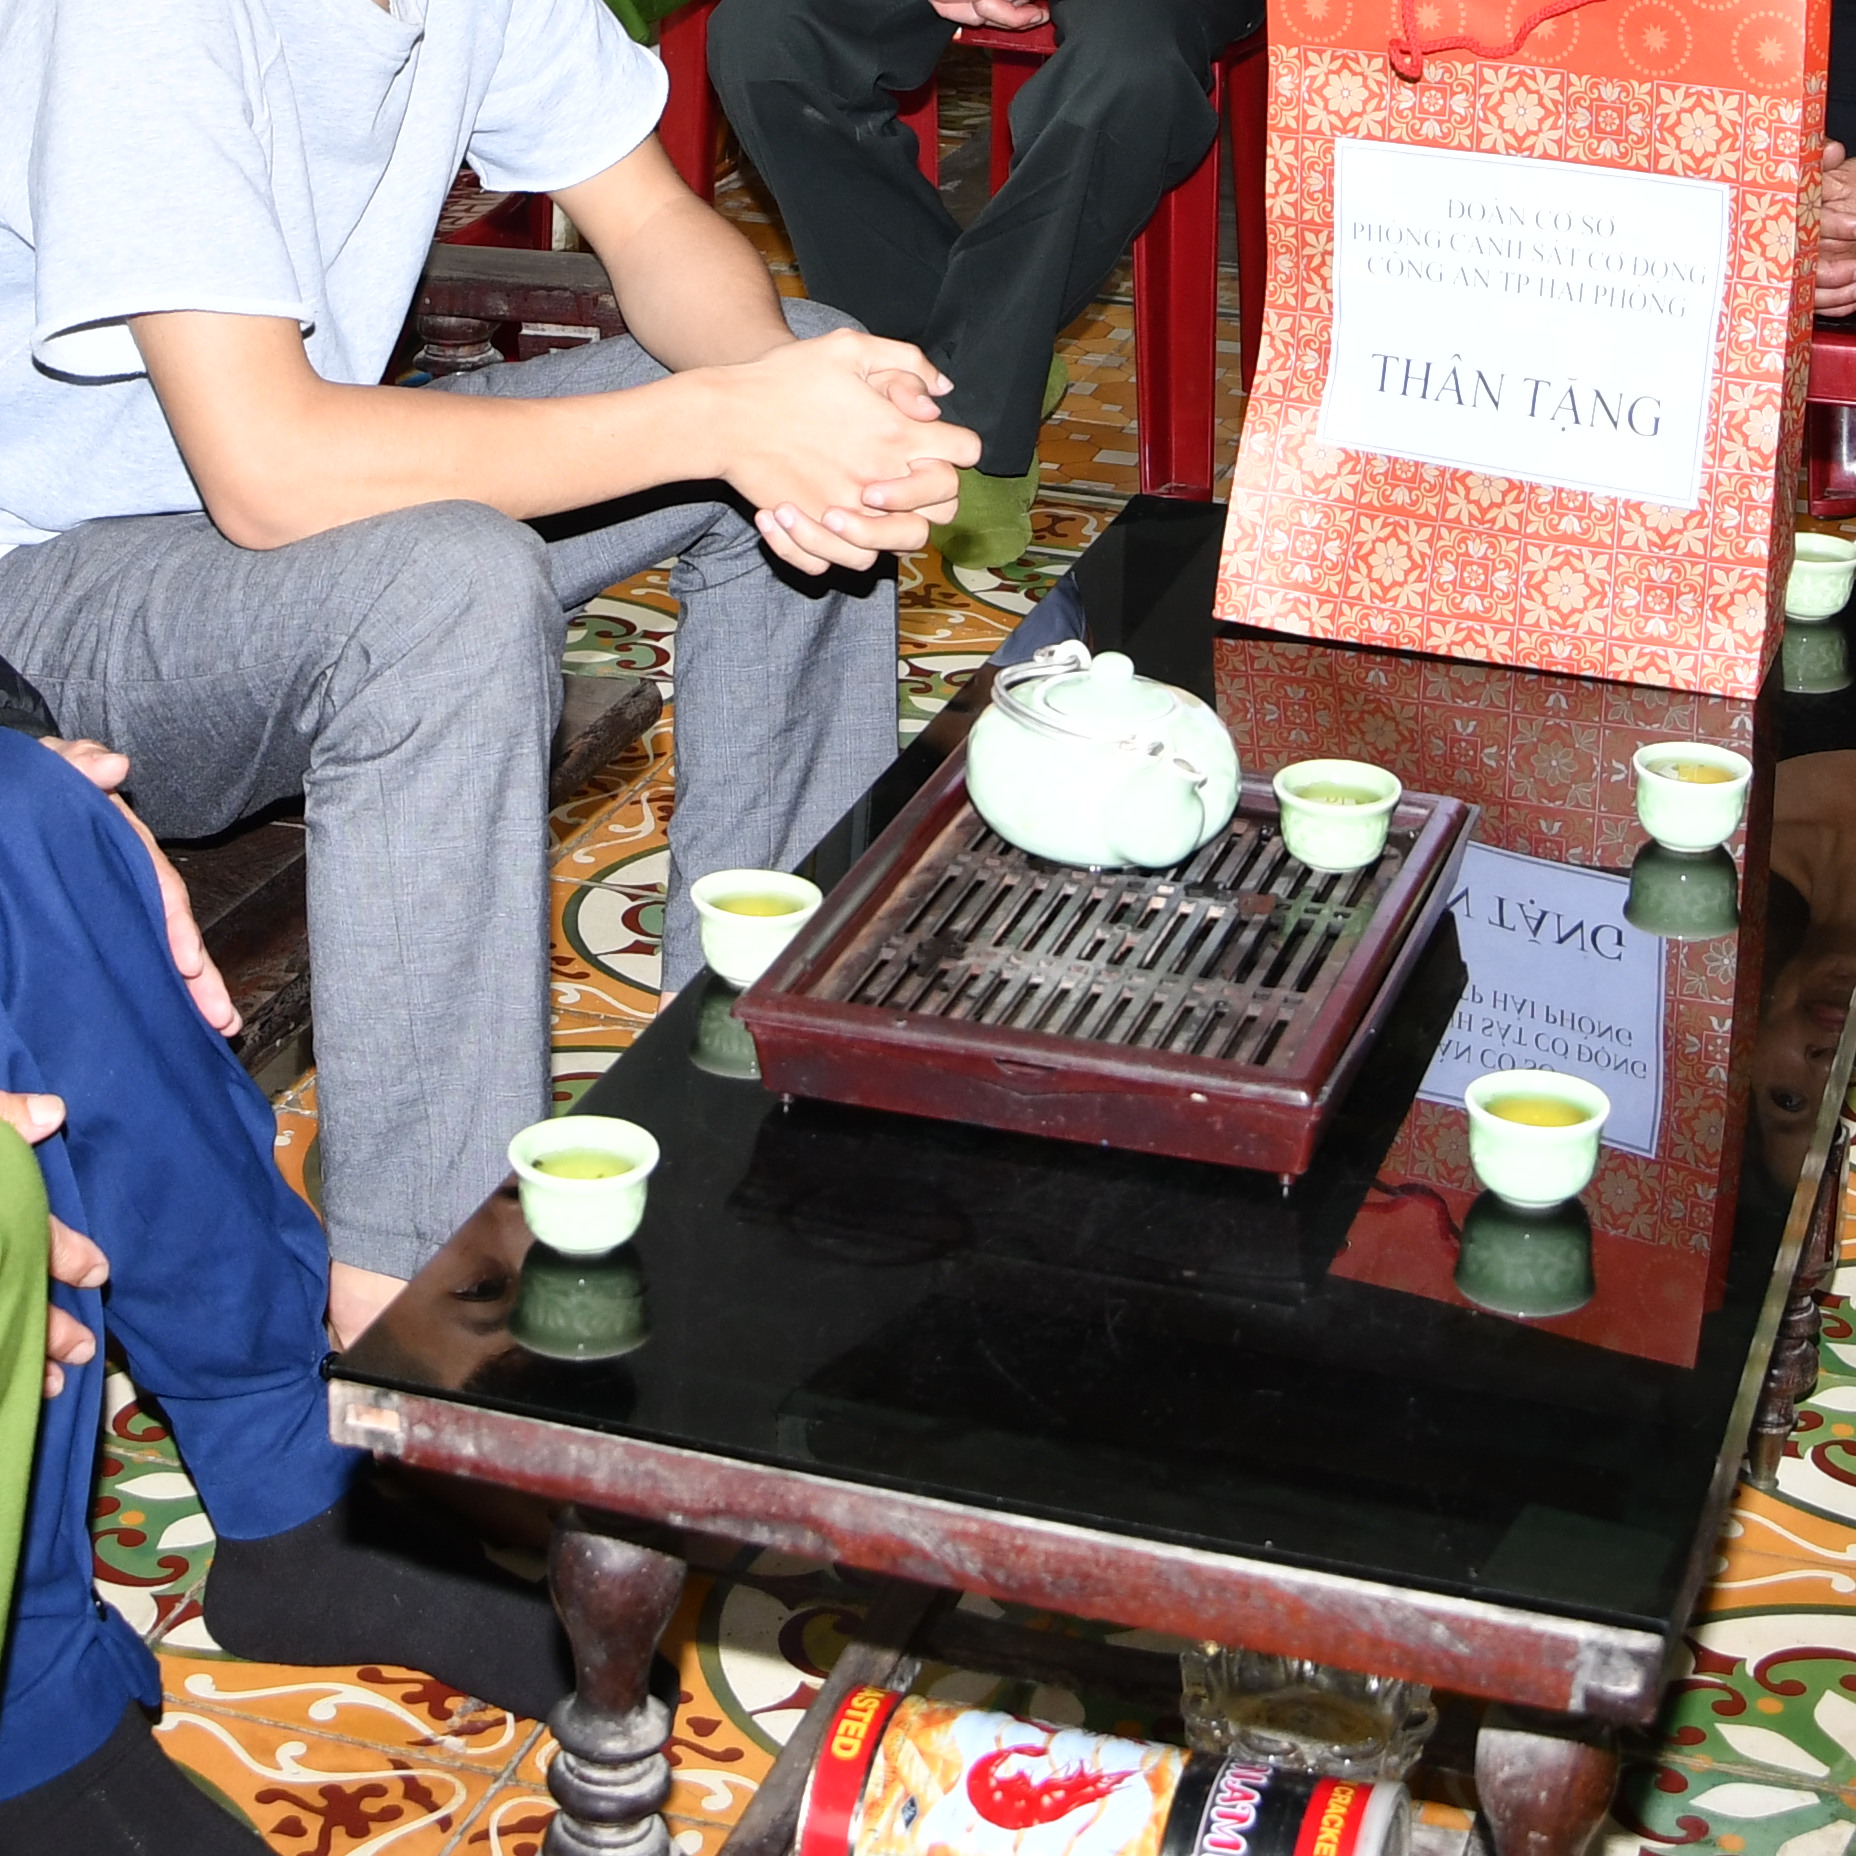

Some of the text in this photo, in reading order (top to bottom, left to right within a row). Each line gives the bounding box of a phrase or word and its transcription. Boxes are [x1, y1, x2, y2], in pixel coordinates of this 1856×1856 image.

[1367, 250, 1443, 283] CÔNG
[1453, 266, 1490, 288] AN
[1499, 270, 1530, 294] TP
[1370, 353, 1662, 438] THÂN TẶNG
[831, 1685, 888, 1761] ASTED
[1202, 1760, 1274, 1856] NAM
[1312, 1785, 1356, 1856] CRACKE
